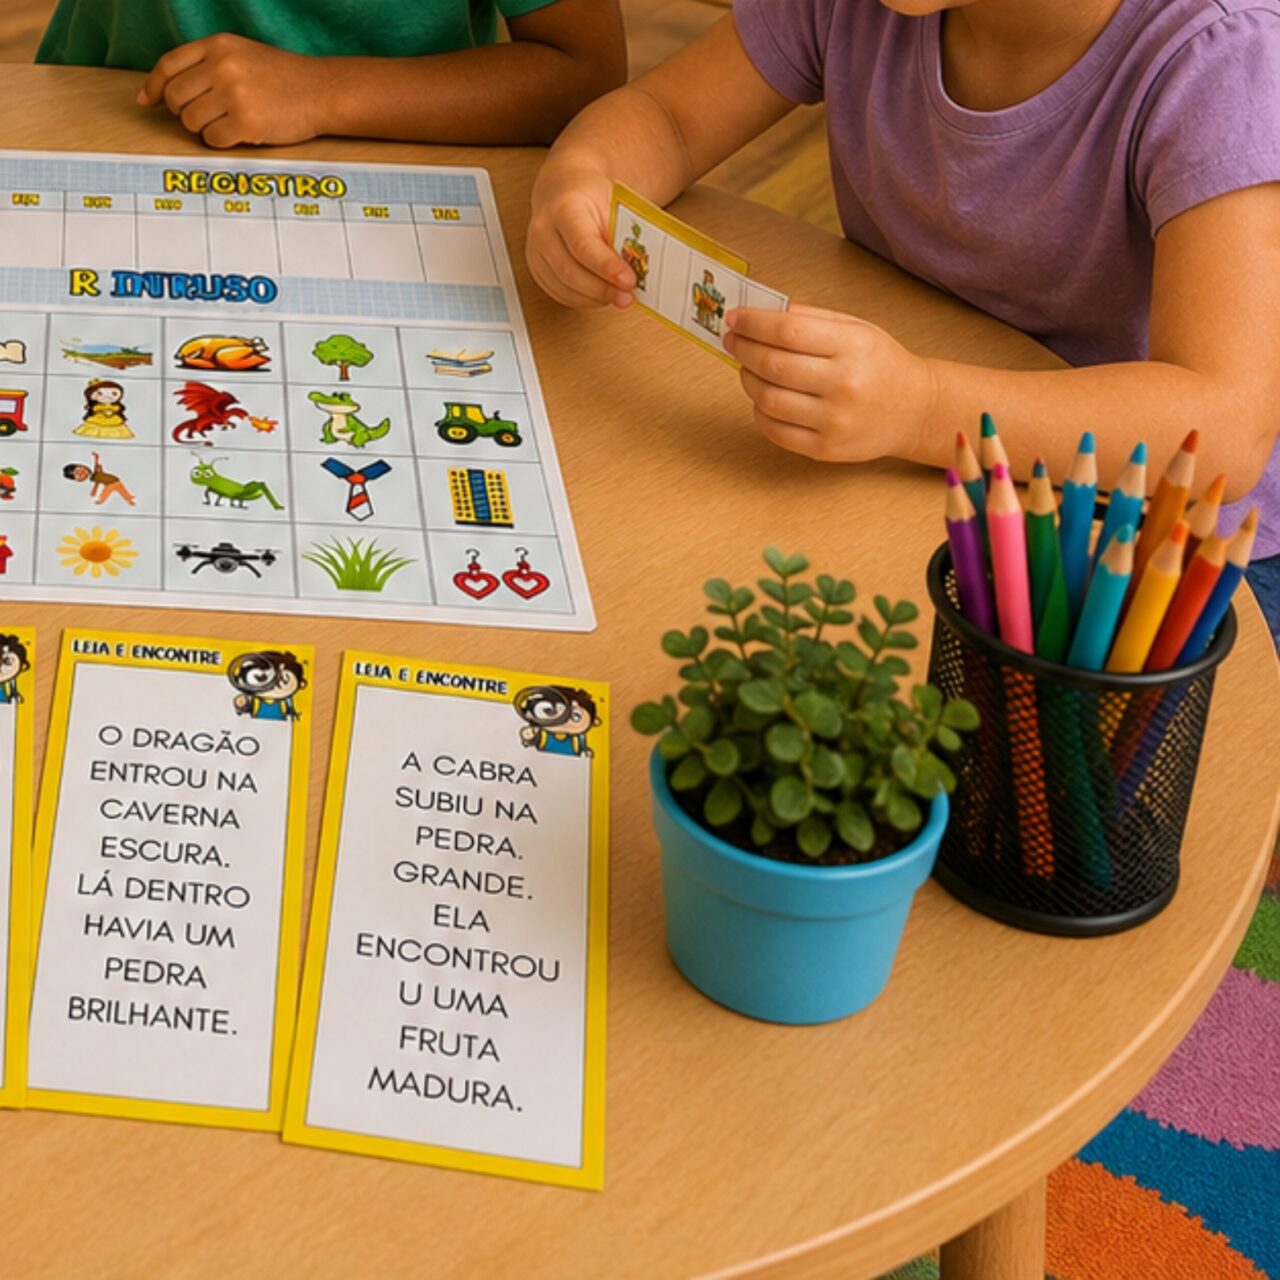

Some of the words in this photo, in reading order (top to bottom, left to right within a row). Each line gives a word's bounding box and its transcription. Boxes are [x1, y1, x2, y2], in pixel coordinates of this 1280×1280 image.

[70, 269, 101, 297] R
[72, 639, 112, 656] LEIA
[116, 642, 126, 656] E
[132, 644, 222, 666] ENCONTRE
[354, 662, 394, 681] LEIA
[399, 666, 410, 681] E
[416, 668, 509, 694] ENCONTRE
[98, 725, 123, 746] O
[132, 727, 260, 757] DRAGÃO
[90, 760, 207, 789] ENTROU
[217, 771, 258, 794] NA
[401, 752, 422, 773] A
[432, 755, 538, 788] CABRA
[99, 798, 240, 830] CAVERNA
[395, 786, 484, 817] SUBIU
[494, 799, 538, 825] NA
[100, 835, 230, 868] ESCURA.
[415, 825, 524, 861] PEDRA.
[77, 869, 114, 897] LÁ
[124, 876, 251, 909] DENTRO
[393, 860, 534, 901] GRANDE.
[83, 913, 175, 943] HAVIA
[185, 922, 235, 949] UM
[433, 903, 491, 933] ELA
[104, 956, 207, 989] PEDRA
[356, 932, 560, 983] ENCONTROU
[68, 995, 237, 1035] BRILHANTE.
[399, 980, 422, 1006] U
[433, 985, 509, 1019] UMA
[399, 1025, 500, 1062] FRUTA
[367, 1066, 523, 1112] MADURA.
